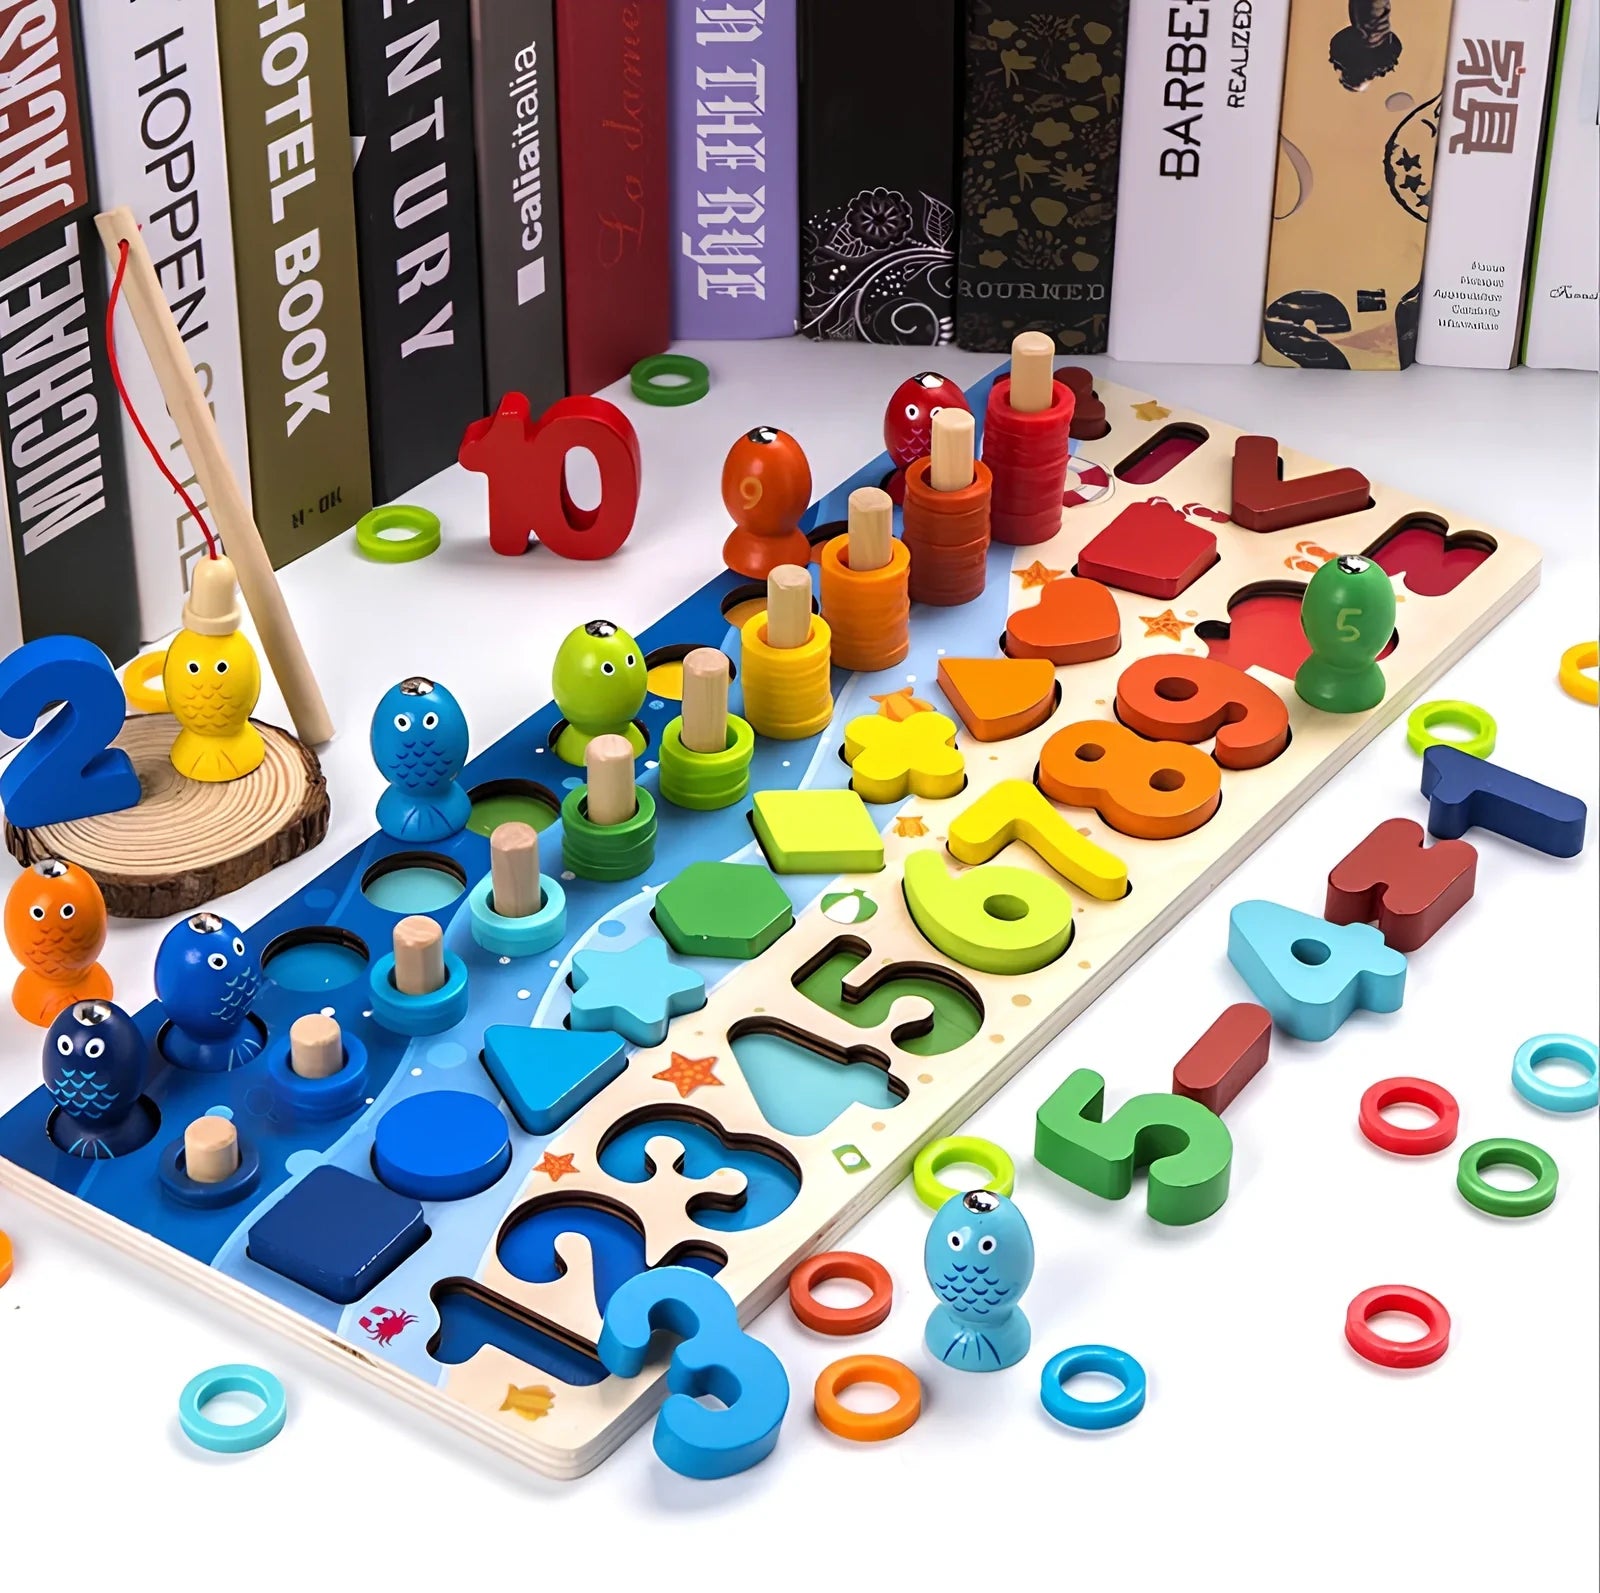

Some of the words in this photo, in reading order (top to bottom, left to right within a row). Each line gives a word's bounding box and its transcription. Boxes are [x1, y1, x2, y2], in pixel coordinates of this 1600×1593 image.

[258, 0, 317, 224] HOTEL
[696, 58, 766, 172] THE
[1159, 0, 1209, 180] BARBE
[1449, 38, 1526, 154] 家具
[383, 0, 454, 360] NTURY
[682, 185, 766, 300] RYE
[0, 222, 105, 556] MICHAEL
[274, 228, 331, 438] BOOK
[739, 476, 764, 510] 9
[1336, 608, 1363, 642] 5
